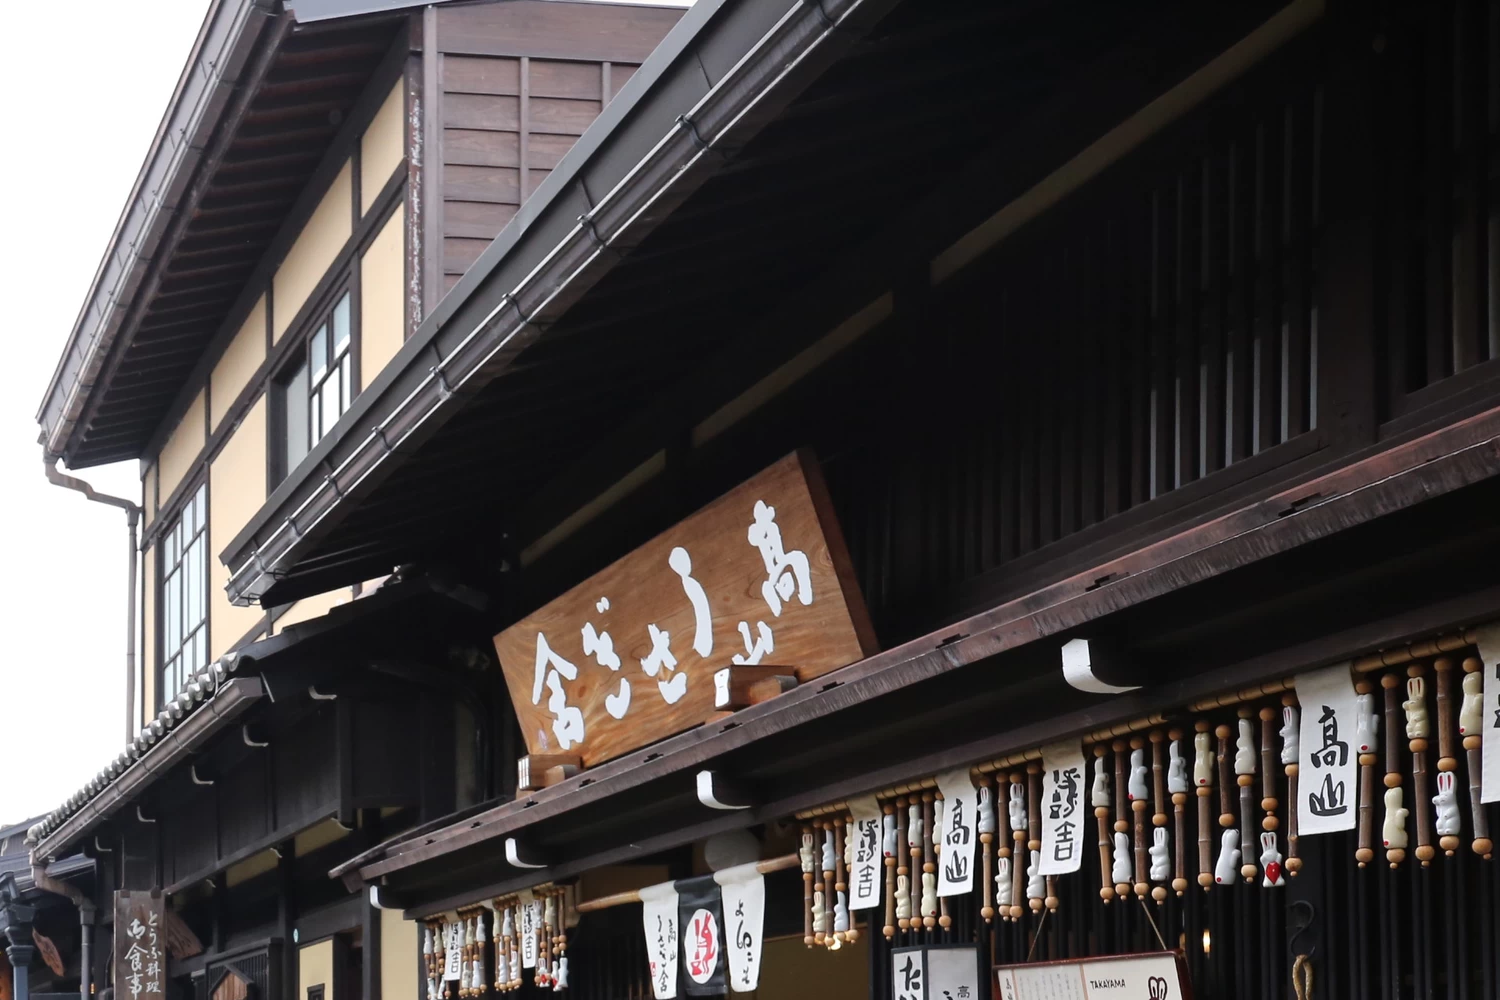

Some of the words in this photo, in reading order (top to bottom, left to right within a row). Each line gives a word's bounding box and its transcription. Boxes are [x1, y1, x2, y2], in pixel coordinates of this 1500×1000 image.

[1309, 705, 1349, 816] 高山
[946, 798, 970, 883] 高山
[146, 911, 162, 993] とうふ料理
[1090, 978, 1126, 989] TAKAYAMA
